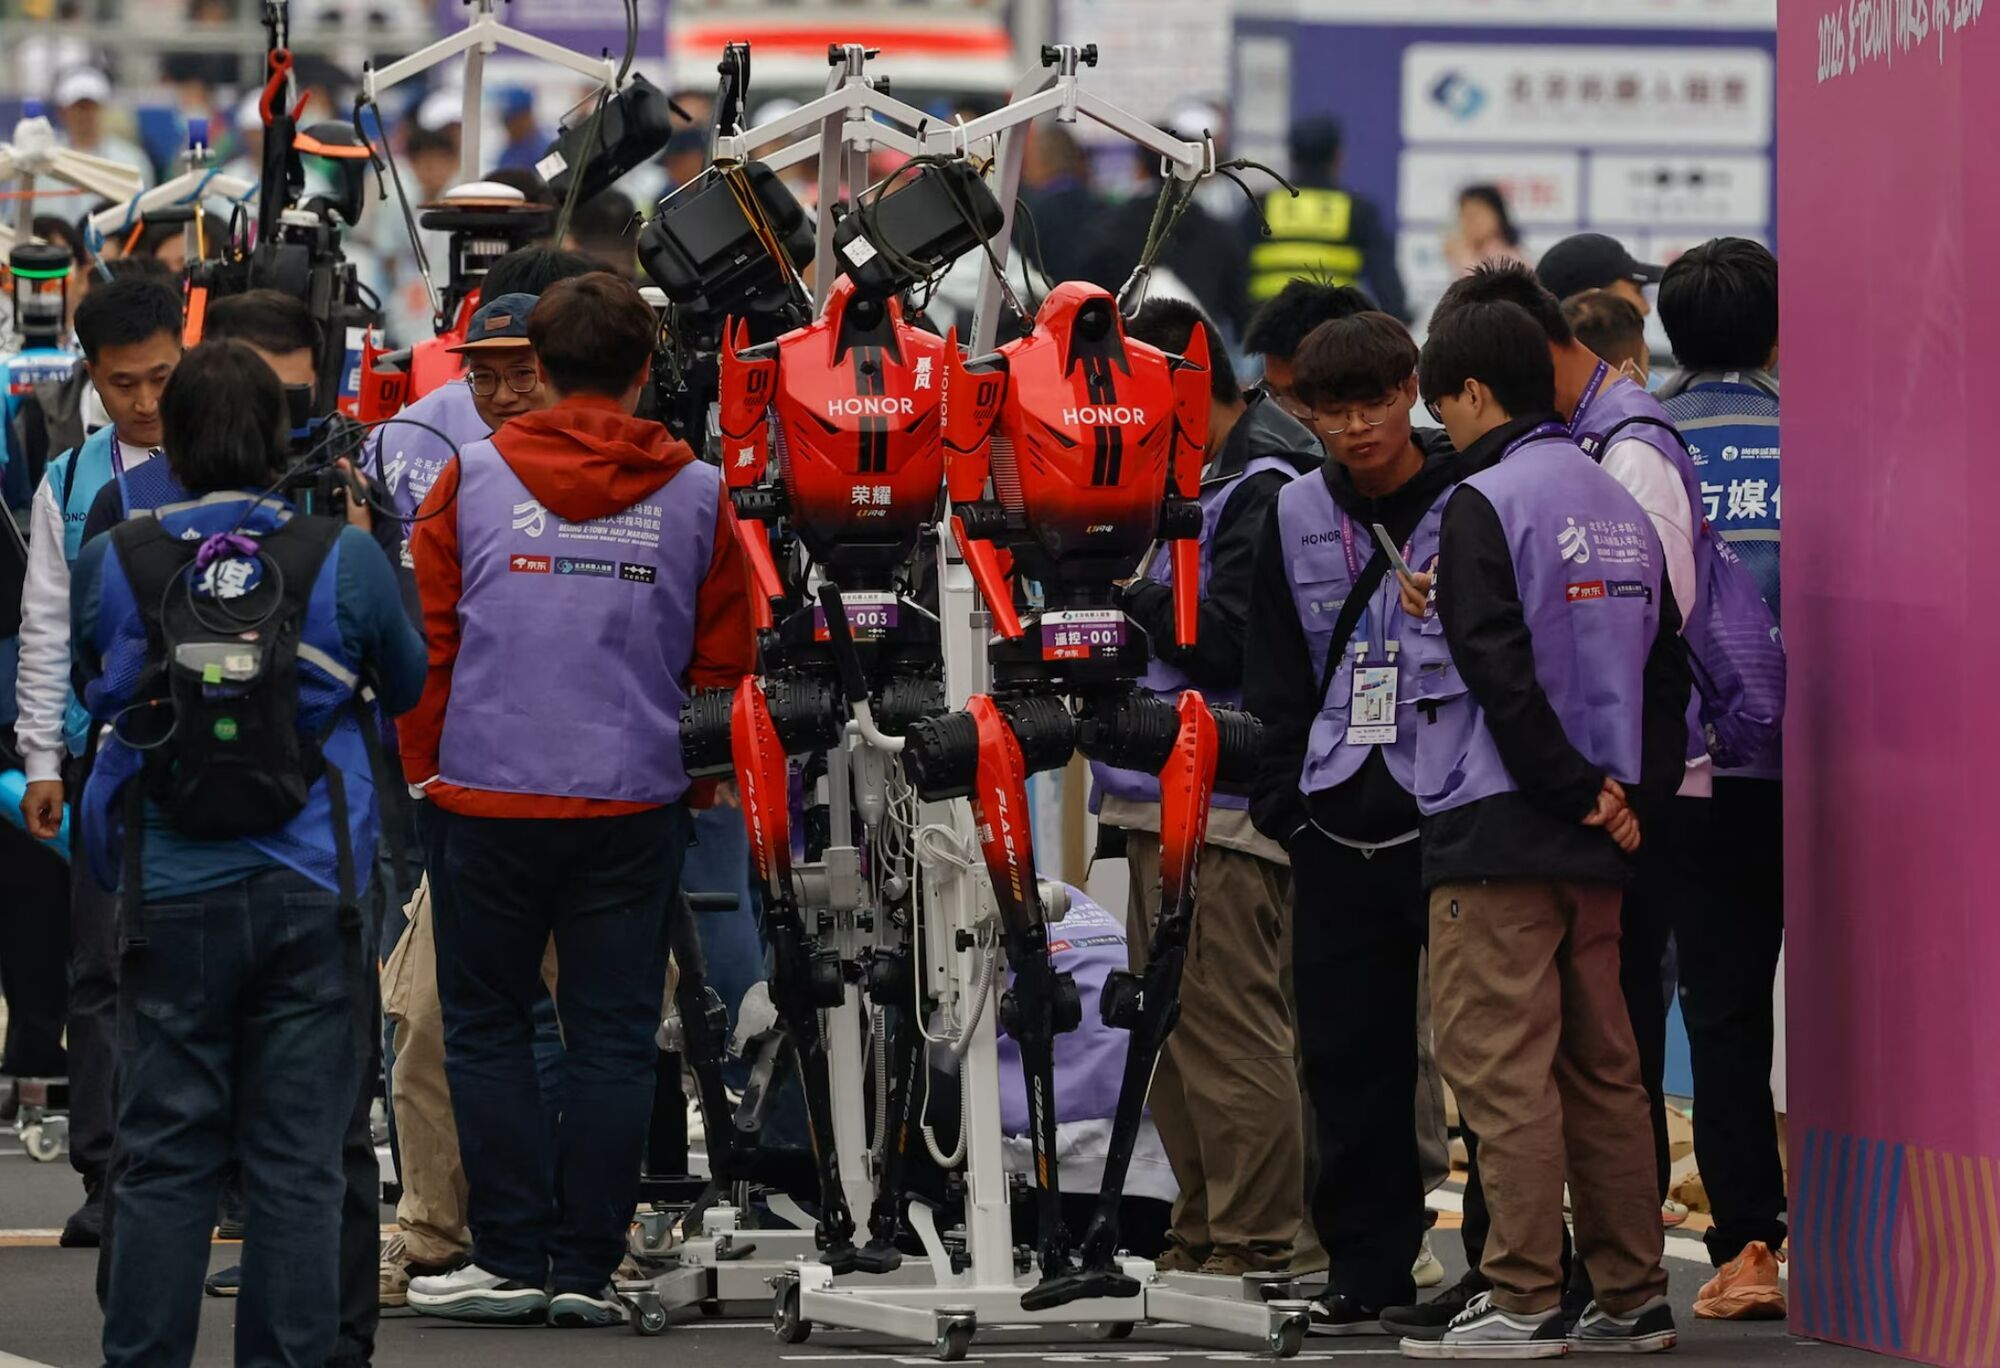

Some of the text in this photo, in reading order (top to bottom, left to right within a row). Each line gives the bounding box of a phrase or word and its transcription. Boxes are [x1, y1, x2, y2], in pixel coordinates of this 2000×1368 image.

[1818, 5, 1845, 84] 2026
[941, 365, 950, 427] HONOR
[828, 397, 914, 417] HONOR
[1063, 407, 1146, 425] HONOR
[851, 485, 892, 505] 荣耀
[63, 511, 87, 522] ONO
[1301, 530, 1342, 546] HONOR
[527, 560, 547, 571] 京东
[745, 768, 762, 846] FLASH
[995, 786, 1017, 865] FLASH
[1034, 1074, 1046, 1154] SPEED
